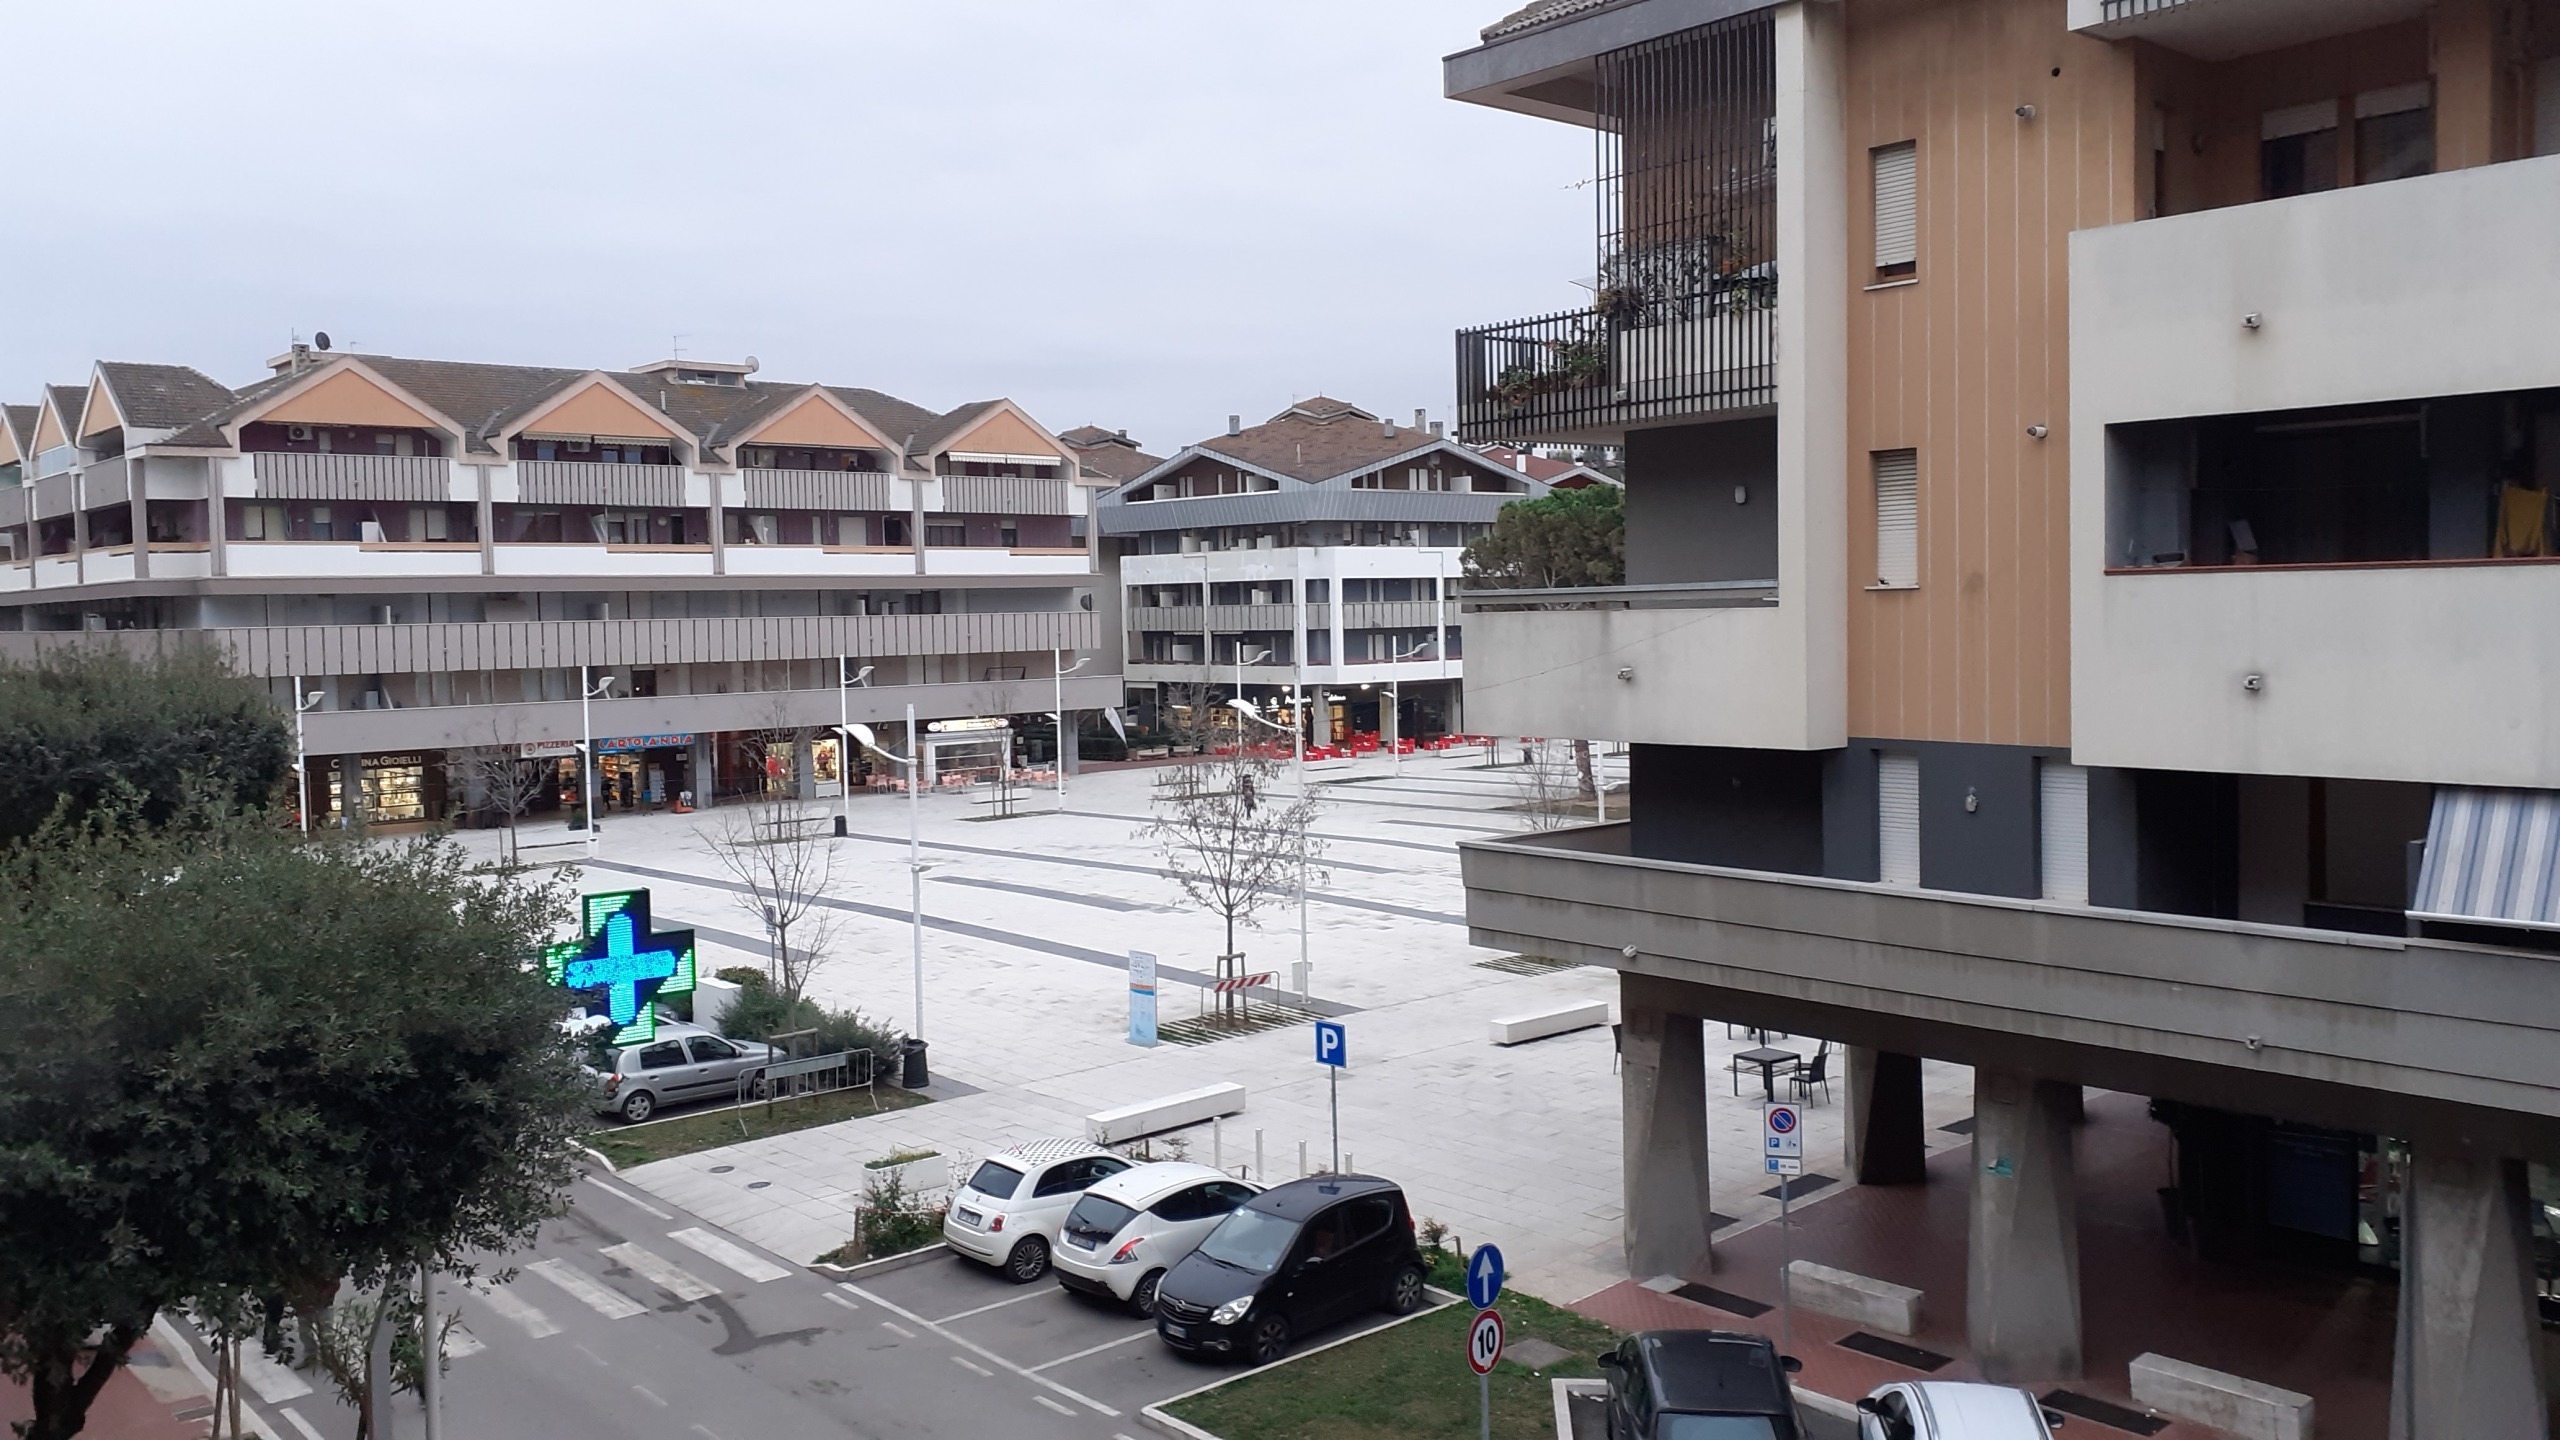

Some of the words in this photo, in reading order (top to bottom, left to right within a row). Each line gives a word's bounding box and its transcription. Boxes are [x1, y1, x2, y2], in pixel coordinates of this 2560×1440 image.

[536, 740, 574, 749] PIZZERIA
[1321, 1027, 1339, 1059] P
[1478, 1325, 1496, 1359] 10
